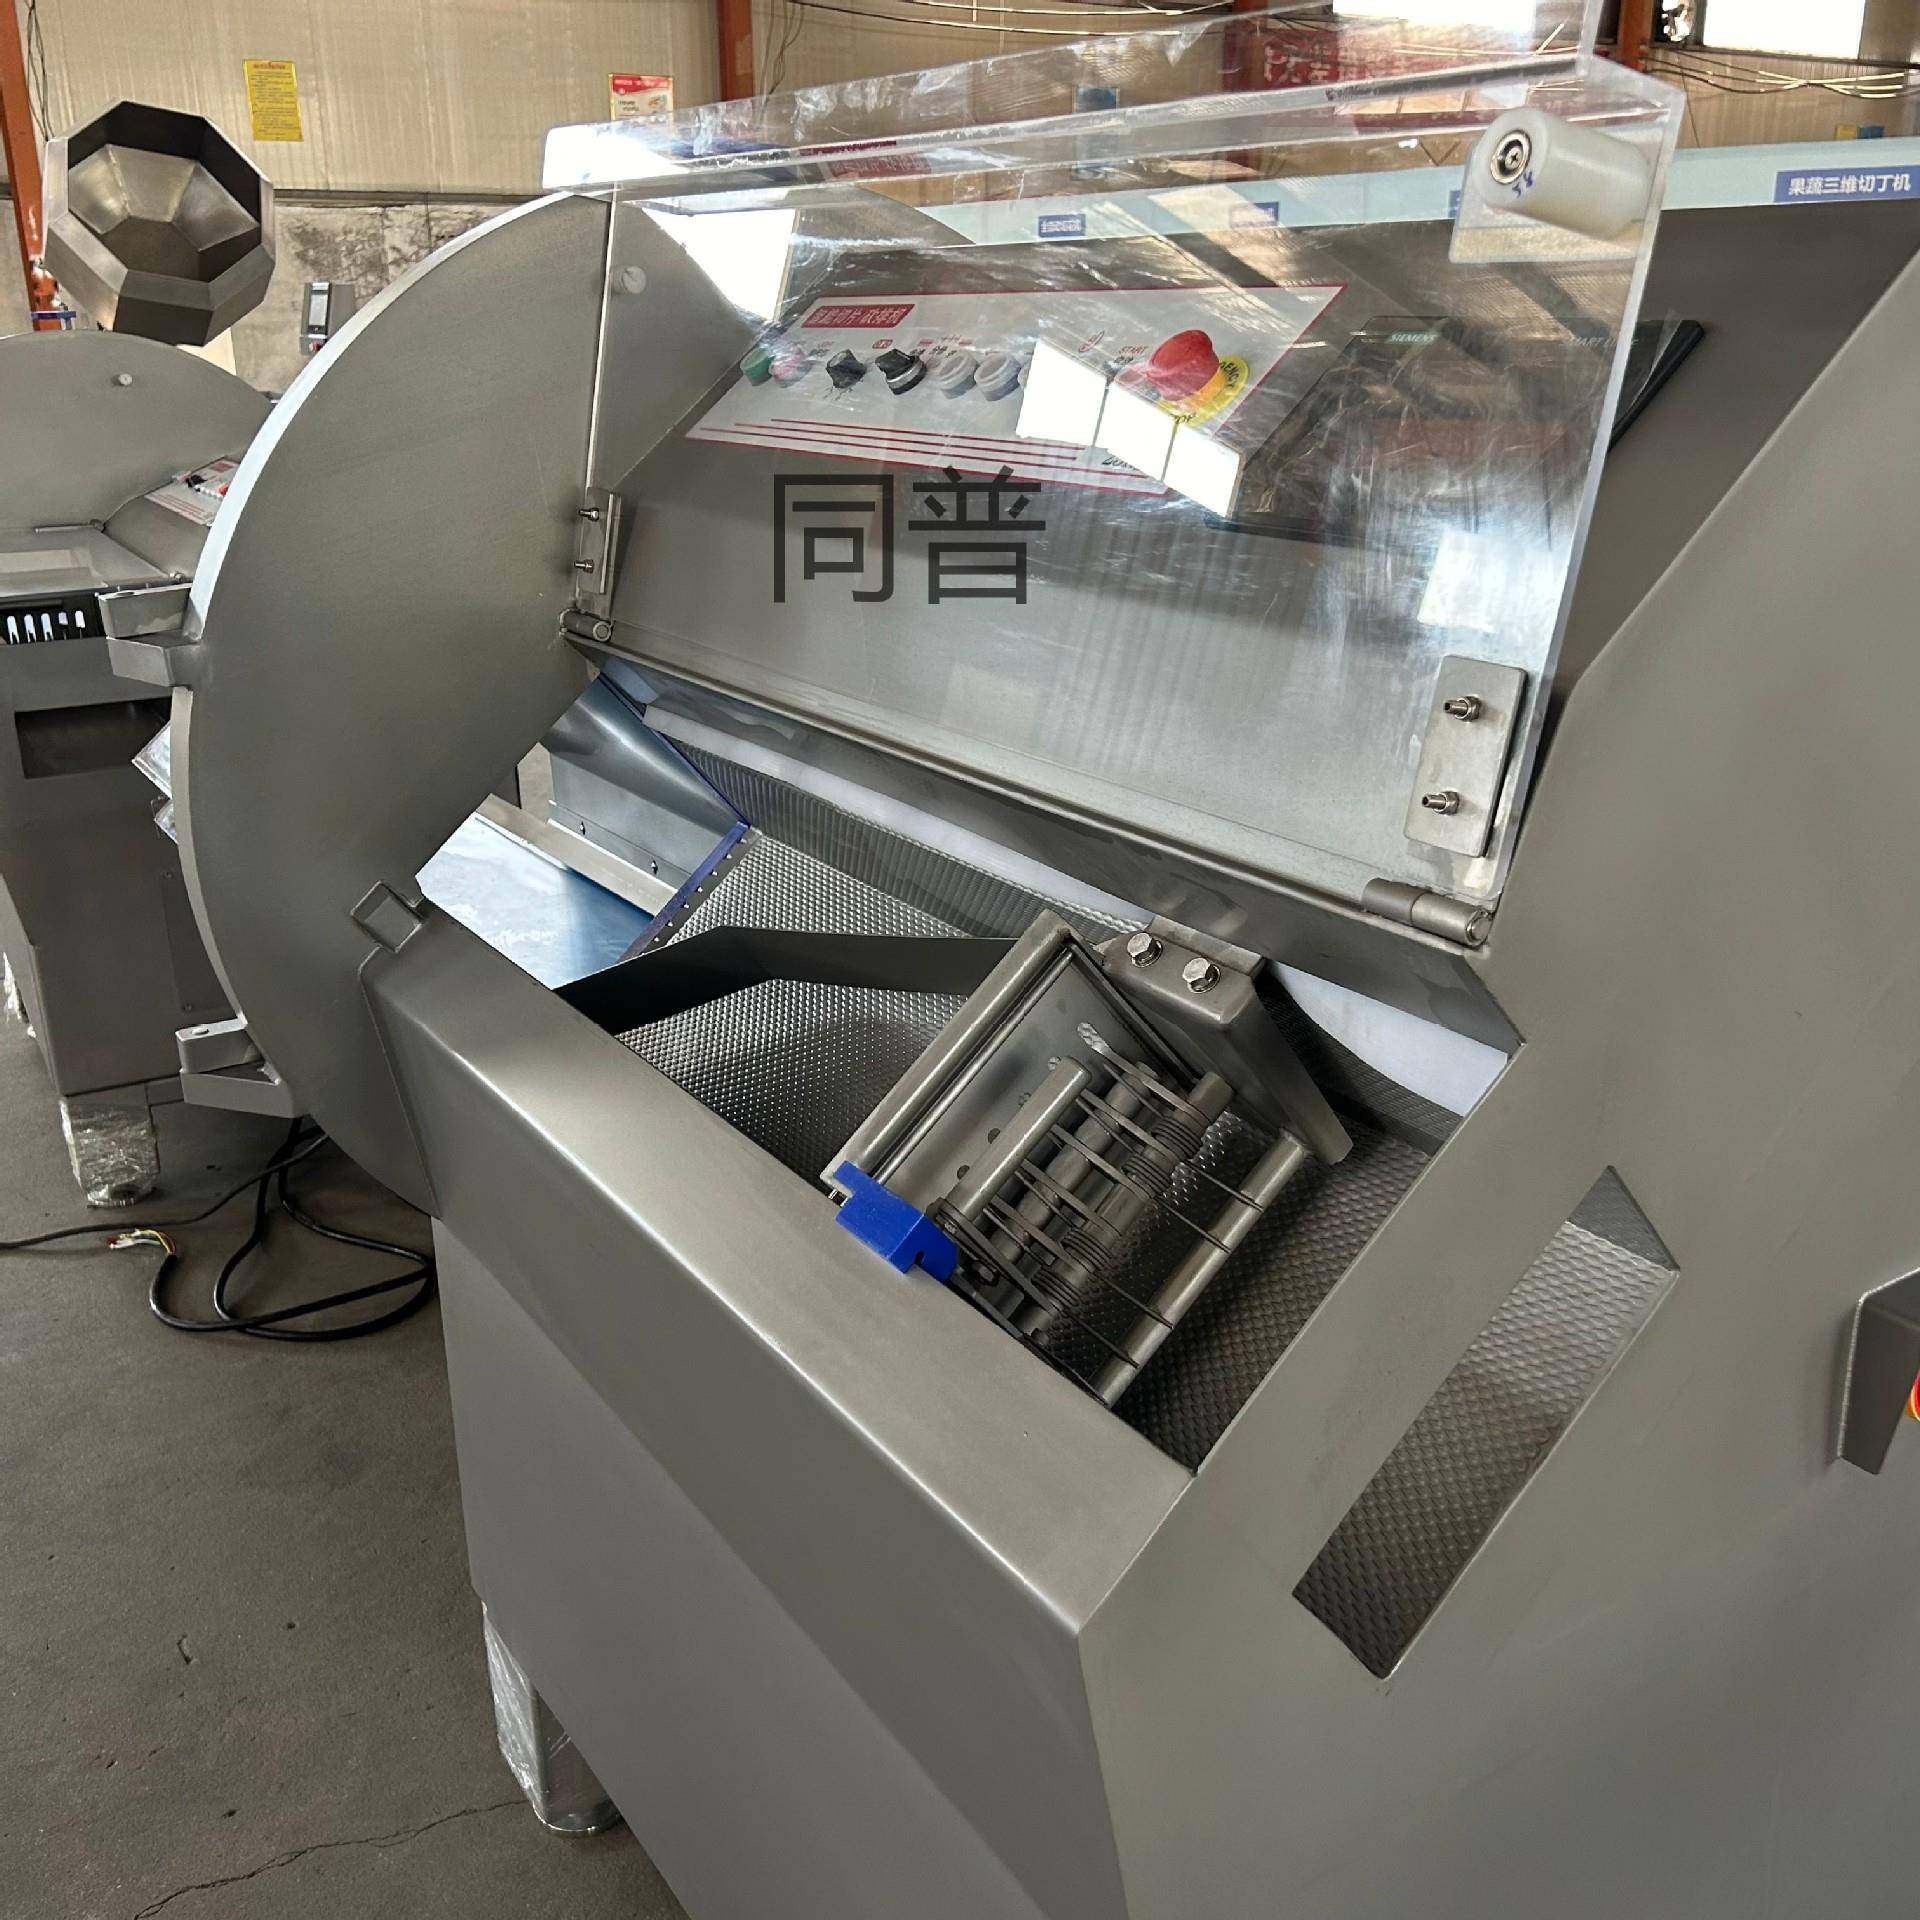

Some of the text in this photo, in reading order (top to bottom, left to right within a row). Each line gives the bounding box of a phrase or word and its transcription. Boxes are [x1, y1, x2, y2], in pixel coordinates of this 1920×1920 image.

[1788, 173, 1912, 196] 果蔬三维切丁机
[1391, 333, 1437, 344] SIEMENS
